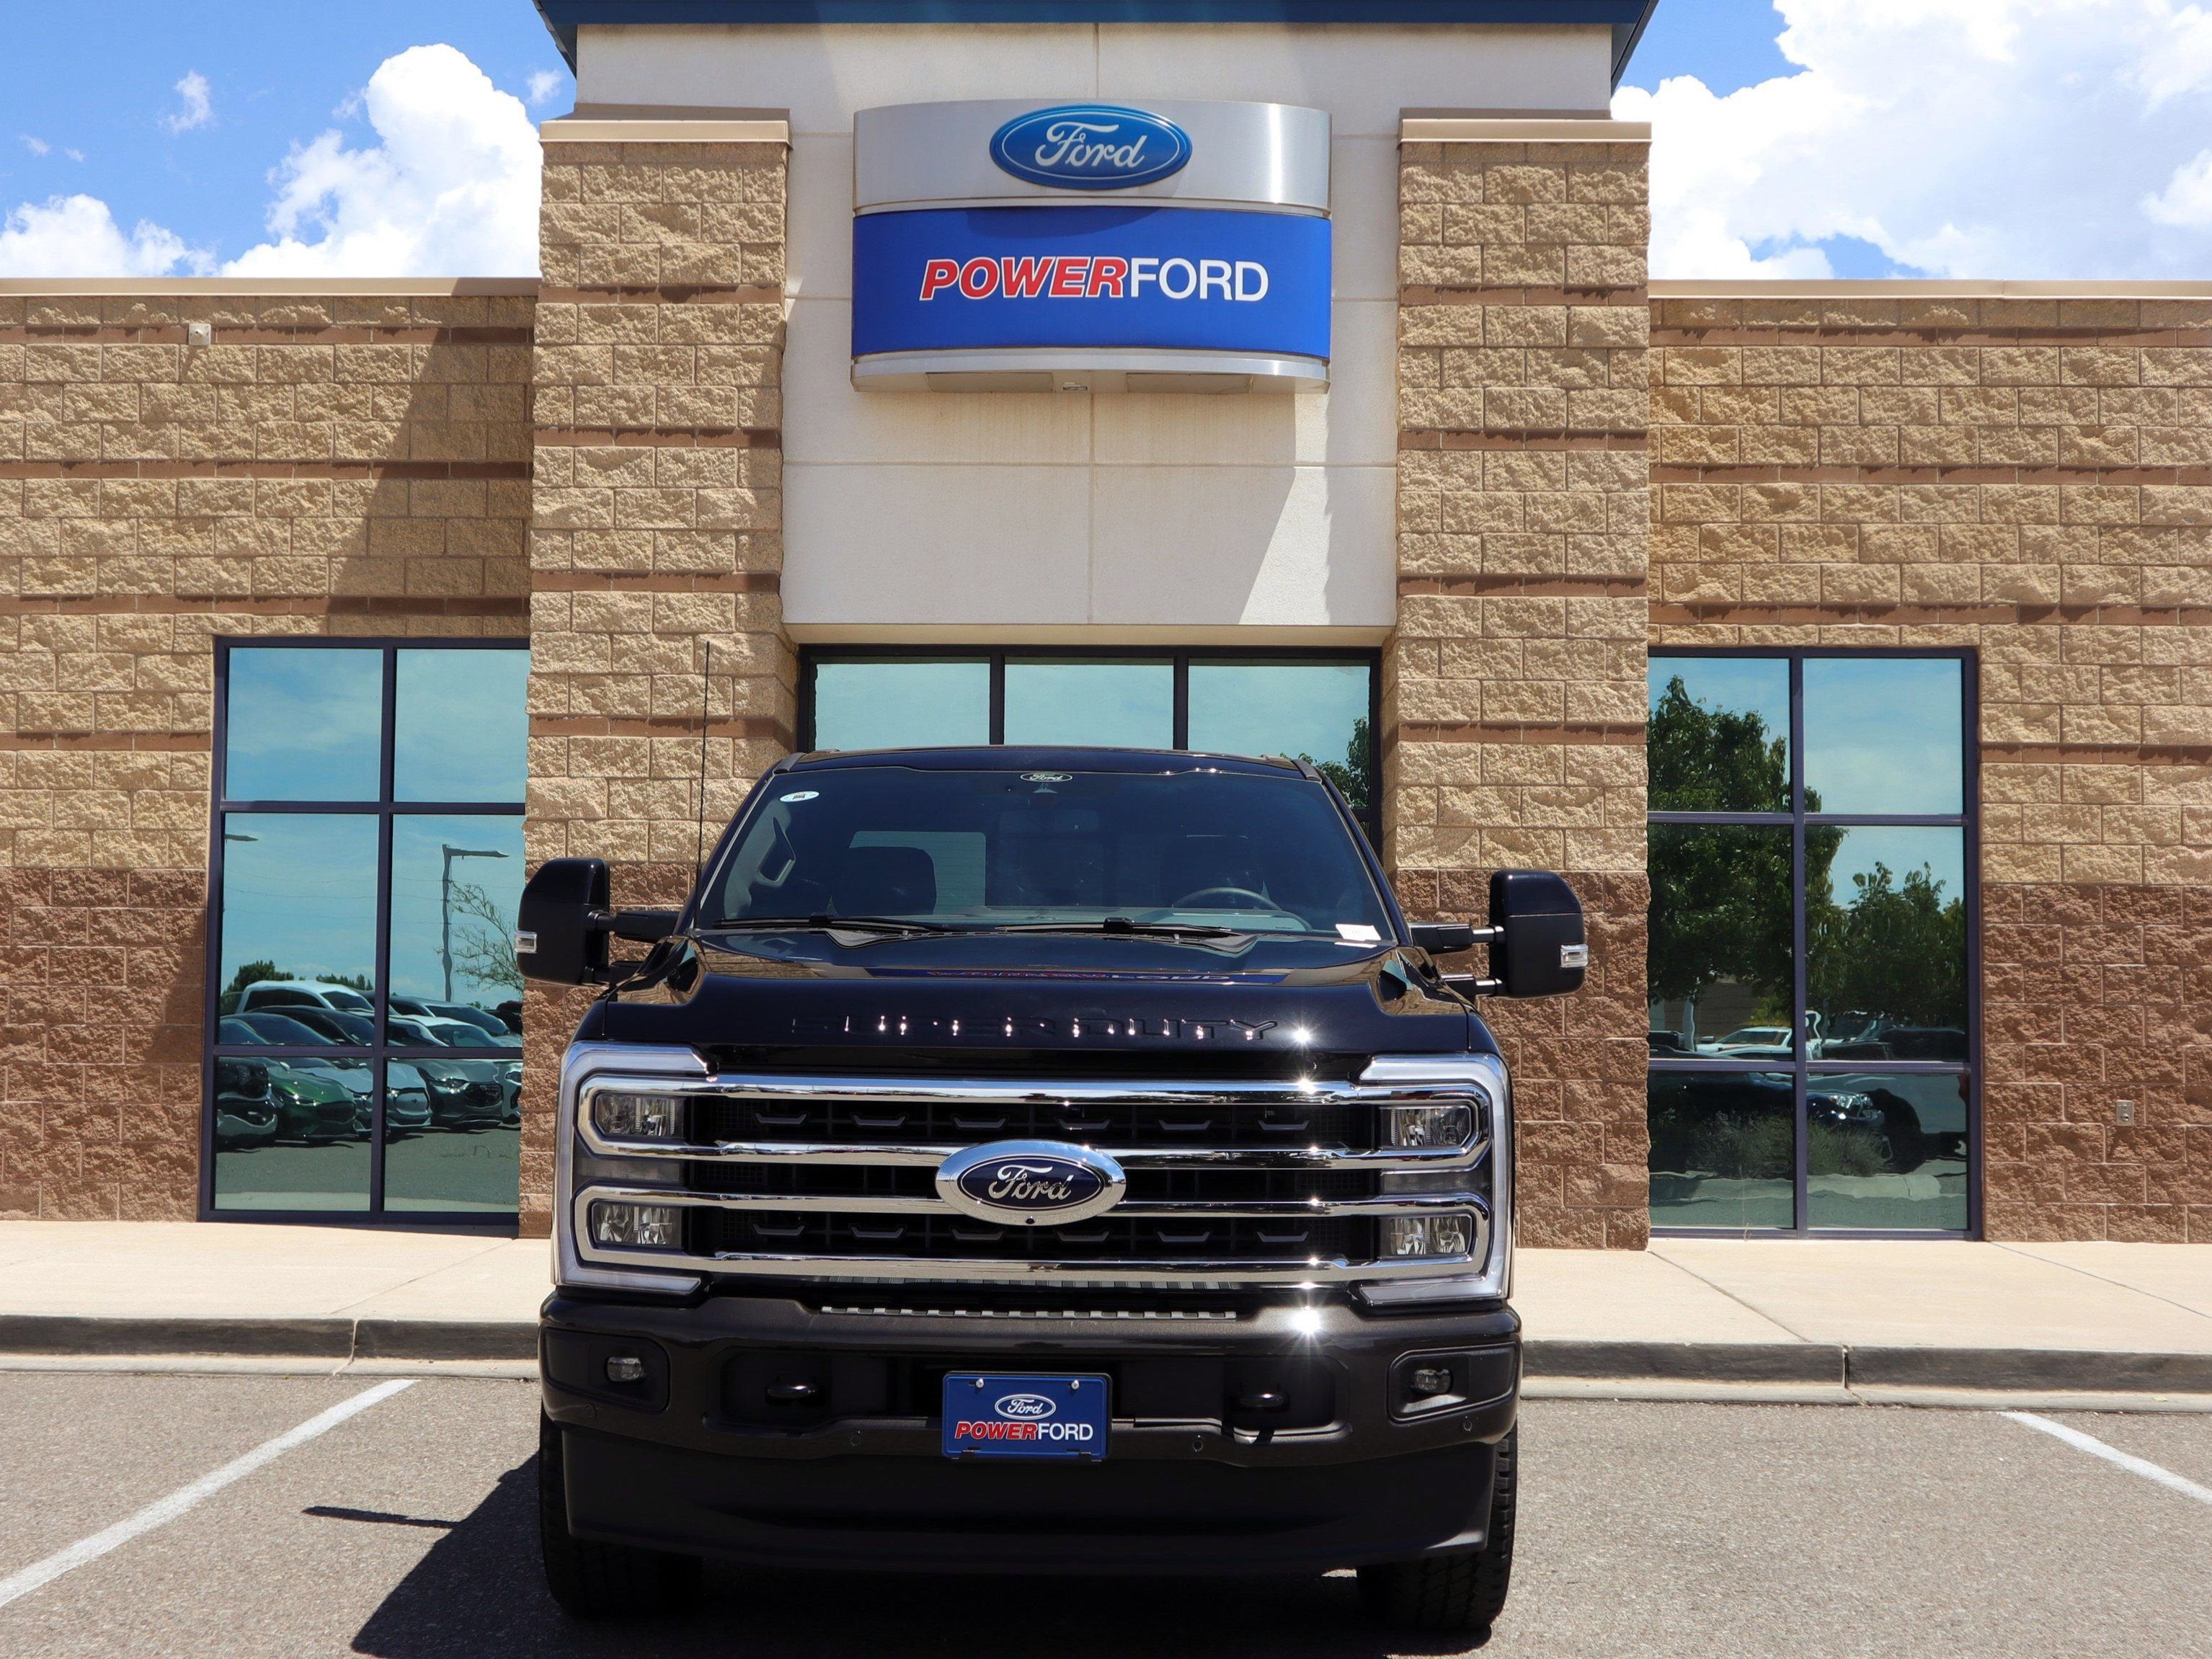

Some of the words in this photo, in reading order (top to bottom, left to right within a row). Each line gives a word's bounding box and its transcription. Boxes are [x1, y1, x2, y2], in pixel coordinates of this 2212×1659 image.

[1035, 121, 1147, 168] Ford
[919, 256, 1269, 303] POWERFORD
[1074, 1018, 1278, 1040] DUTY
[988, 1165, 1075, 1201] Ford
[1007, 1399, 1043, 1415] Ford
[954, 1421, 1093, 1441] POWERFORD
